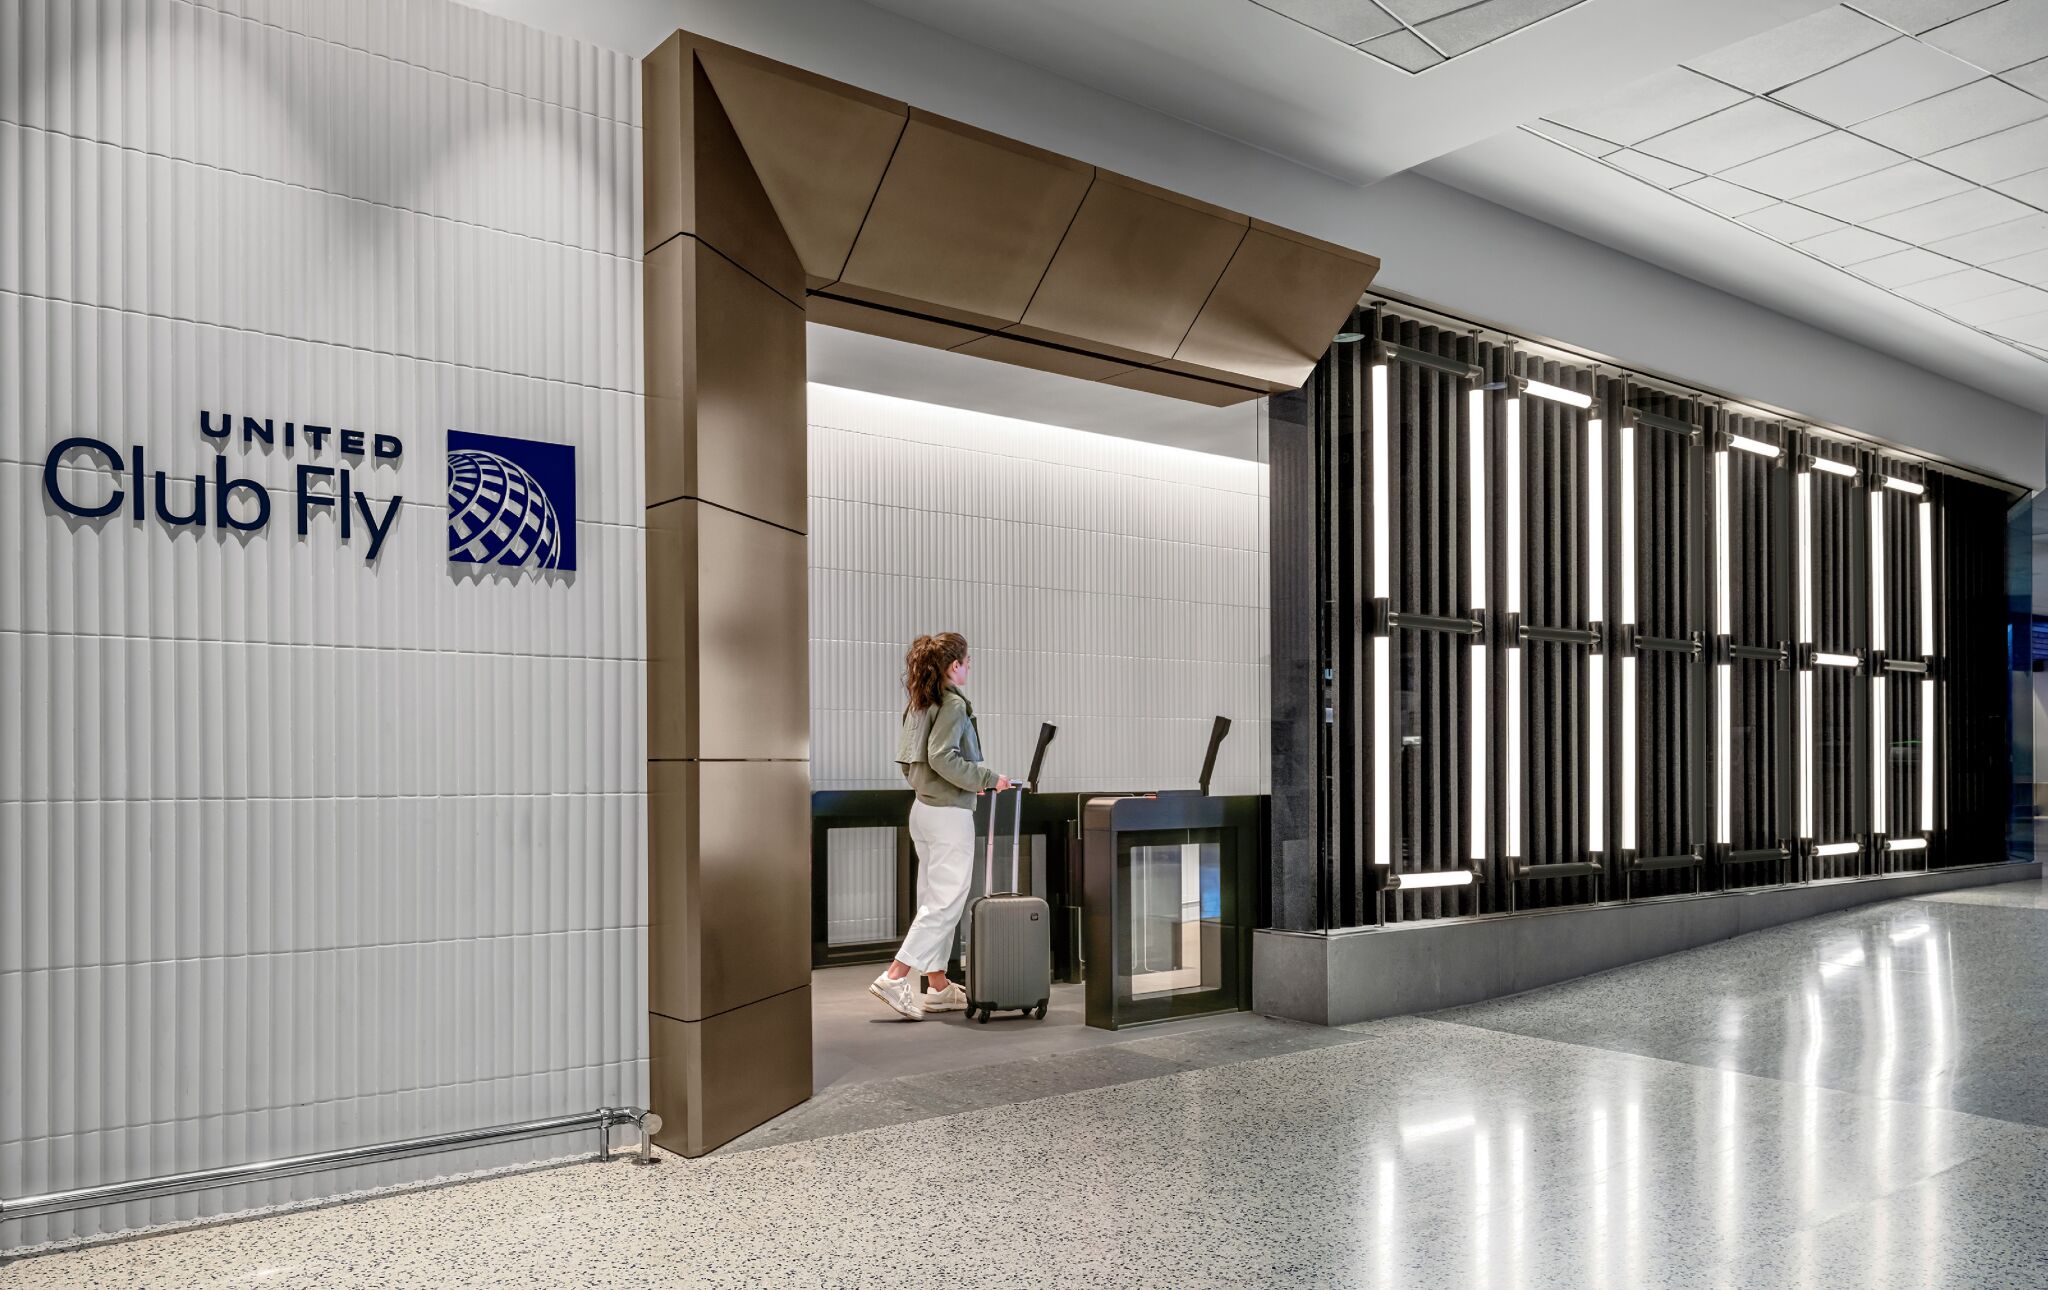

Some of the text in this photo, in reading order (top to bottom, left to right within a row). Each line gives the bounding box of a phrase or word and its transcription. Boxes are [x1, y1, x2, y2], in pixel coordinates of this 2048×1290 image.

[201, 410, 403, 459] UNITED
[44, 437, 402, 560] Club Fly
